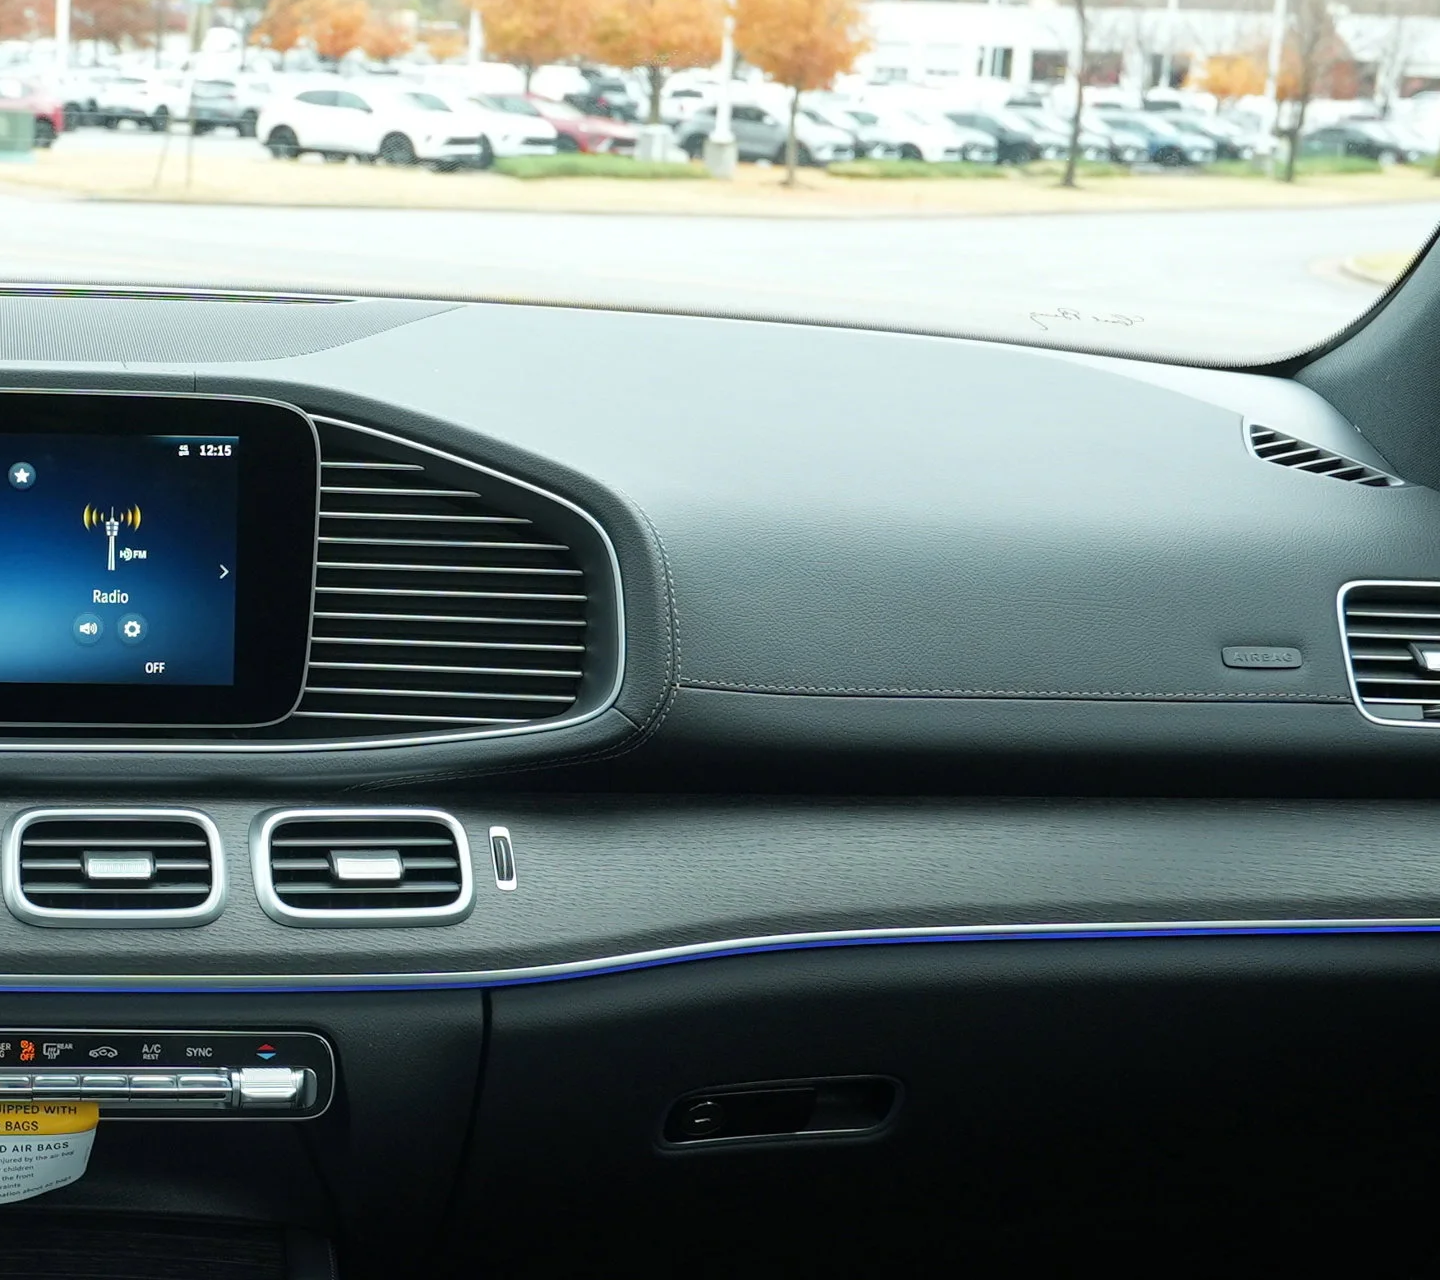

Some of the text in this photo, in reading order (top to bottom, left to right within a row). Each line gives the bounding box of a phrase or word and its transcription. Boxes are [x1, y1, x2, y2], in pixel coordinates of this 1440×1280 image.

[200, 444, 232, 457] 12:15
[133, 550, 147, 559] FM
[93, 589, 129, 604] Radio
[1233, 651, 1293, 663] AIRBAG
[145, 662, 165, 674] OFF
[142, 1044, 162, 1053] A/C
[186, 1047, 213, 1057] SYNC
[20, 1053, 35, 1061] OFF
[44, 1105, 77, 1115] WITH
[5, 1121, 39, 1131] BAGS
[12, 1144, 32, 1153] AIR
[37, 1141, 69, 1151] BAGS
[25, 1156, 33, 1164] by
[23, 1185, 43, 1194] about
[55, 1176, 72, 1185] bags
